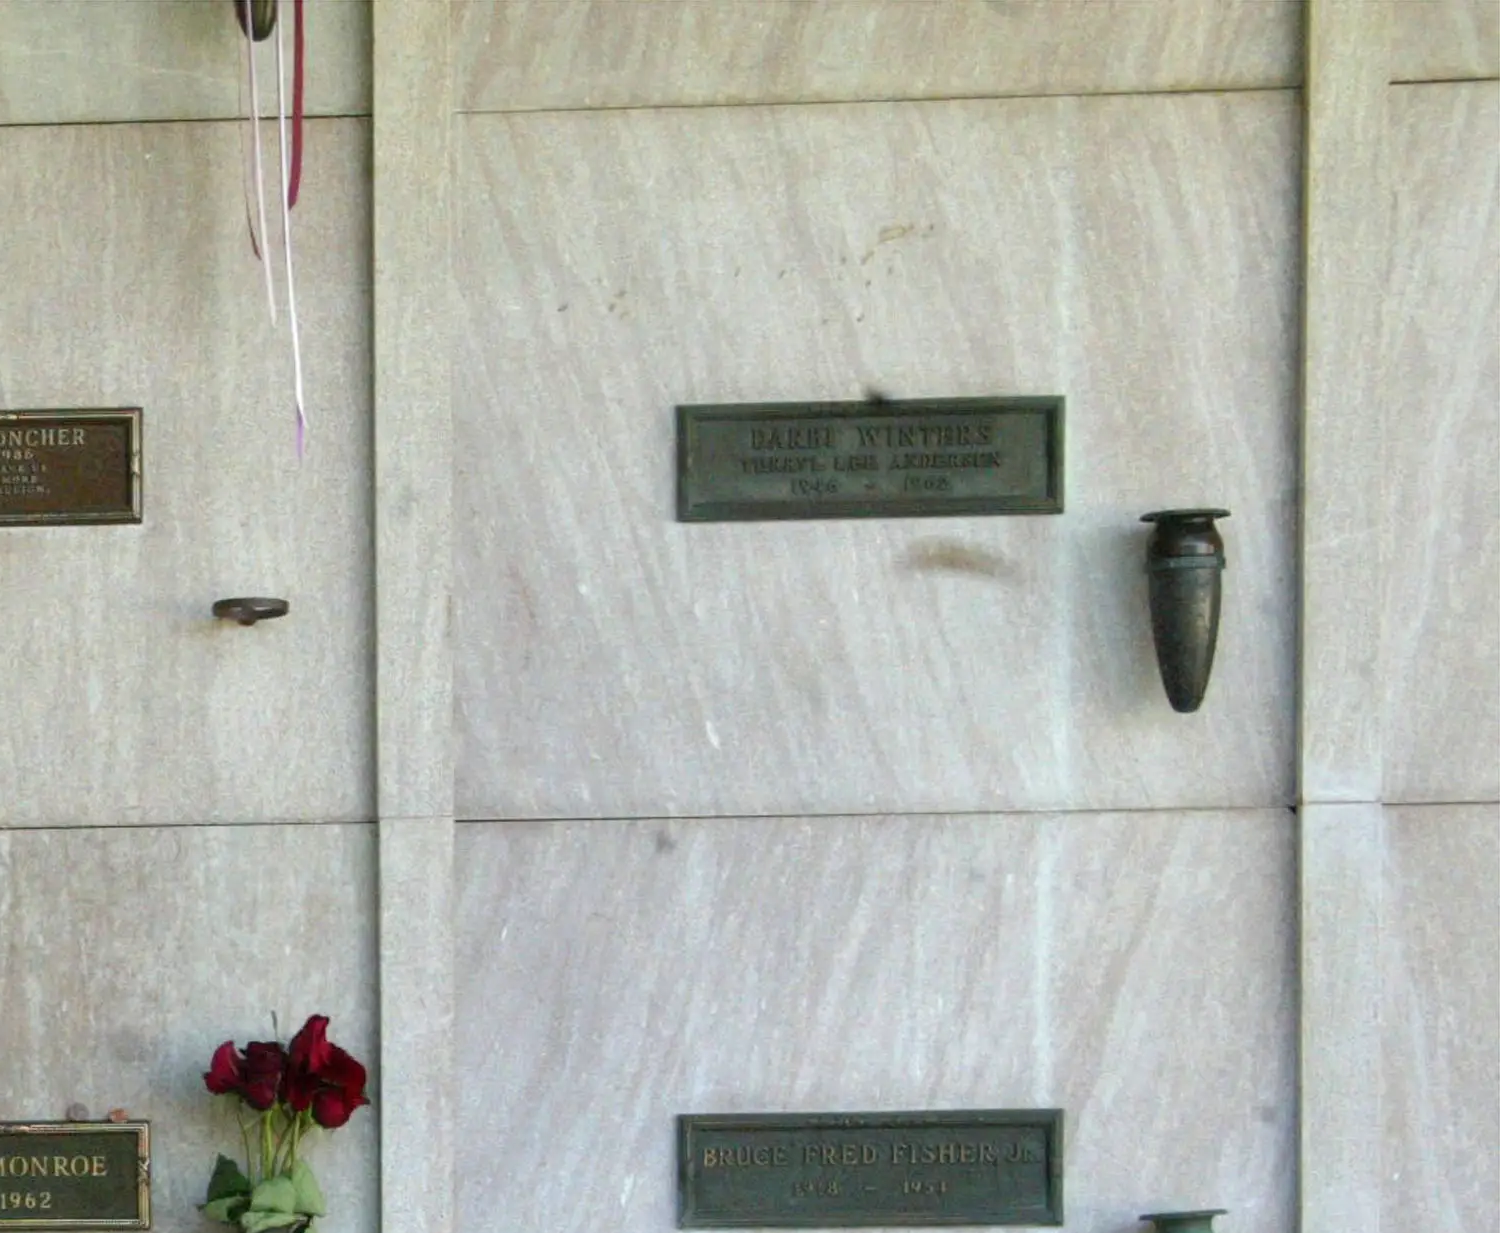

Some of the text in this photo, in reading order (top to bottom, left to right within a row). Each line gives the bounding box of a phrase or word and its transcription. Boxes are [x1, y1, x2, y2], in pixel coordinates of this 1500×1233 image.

[857, 424, 992, 448] WINTERS
[703, 1146, 789, 1168] BRUCE
[804, 1144, 877, 1166] FRED
[892, 1142, 996, 1165] FISHER
[0, 1192, 52, 1210] 1962
